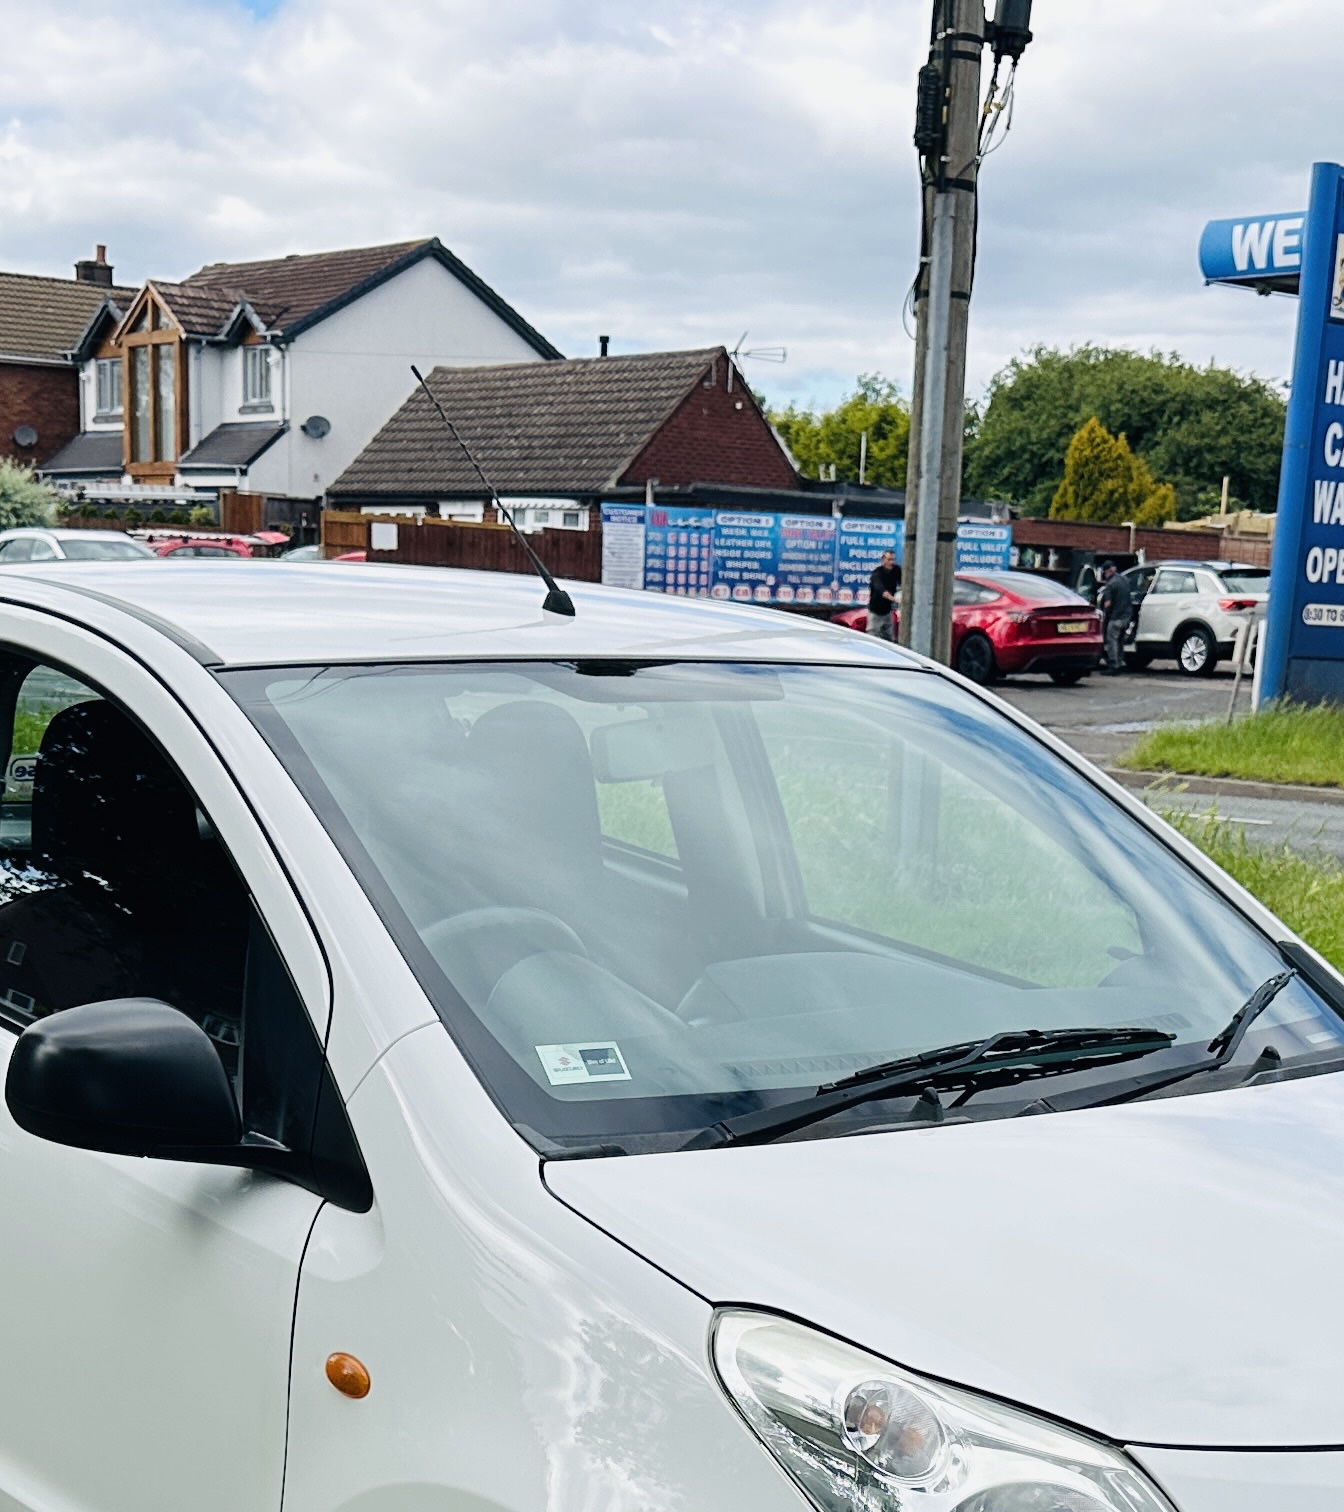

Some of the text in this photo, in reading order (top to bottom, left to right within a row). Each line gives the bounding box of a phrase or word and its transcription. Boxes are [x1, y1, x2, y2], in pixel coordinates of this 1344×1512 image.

[720, 515, 761, 523] OPTION
[785, 519, 822, 527] OPTION
[961, 529, 995, 537] OPTION
[1326, 609, 1337, 622] TO
